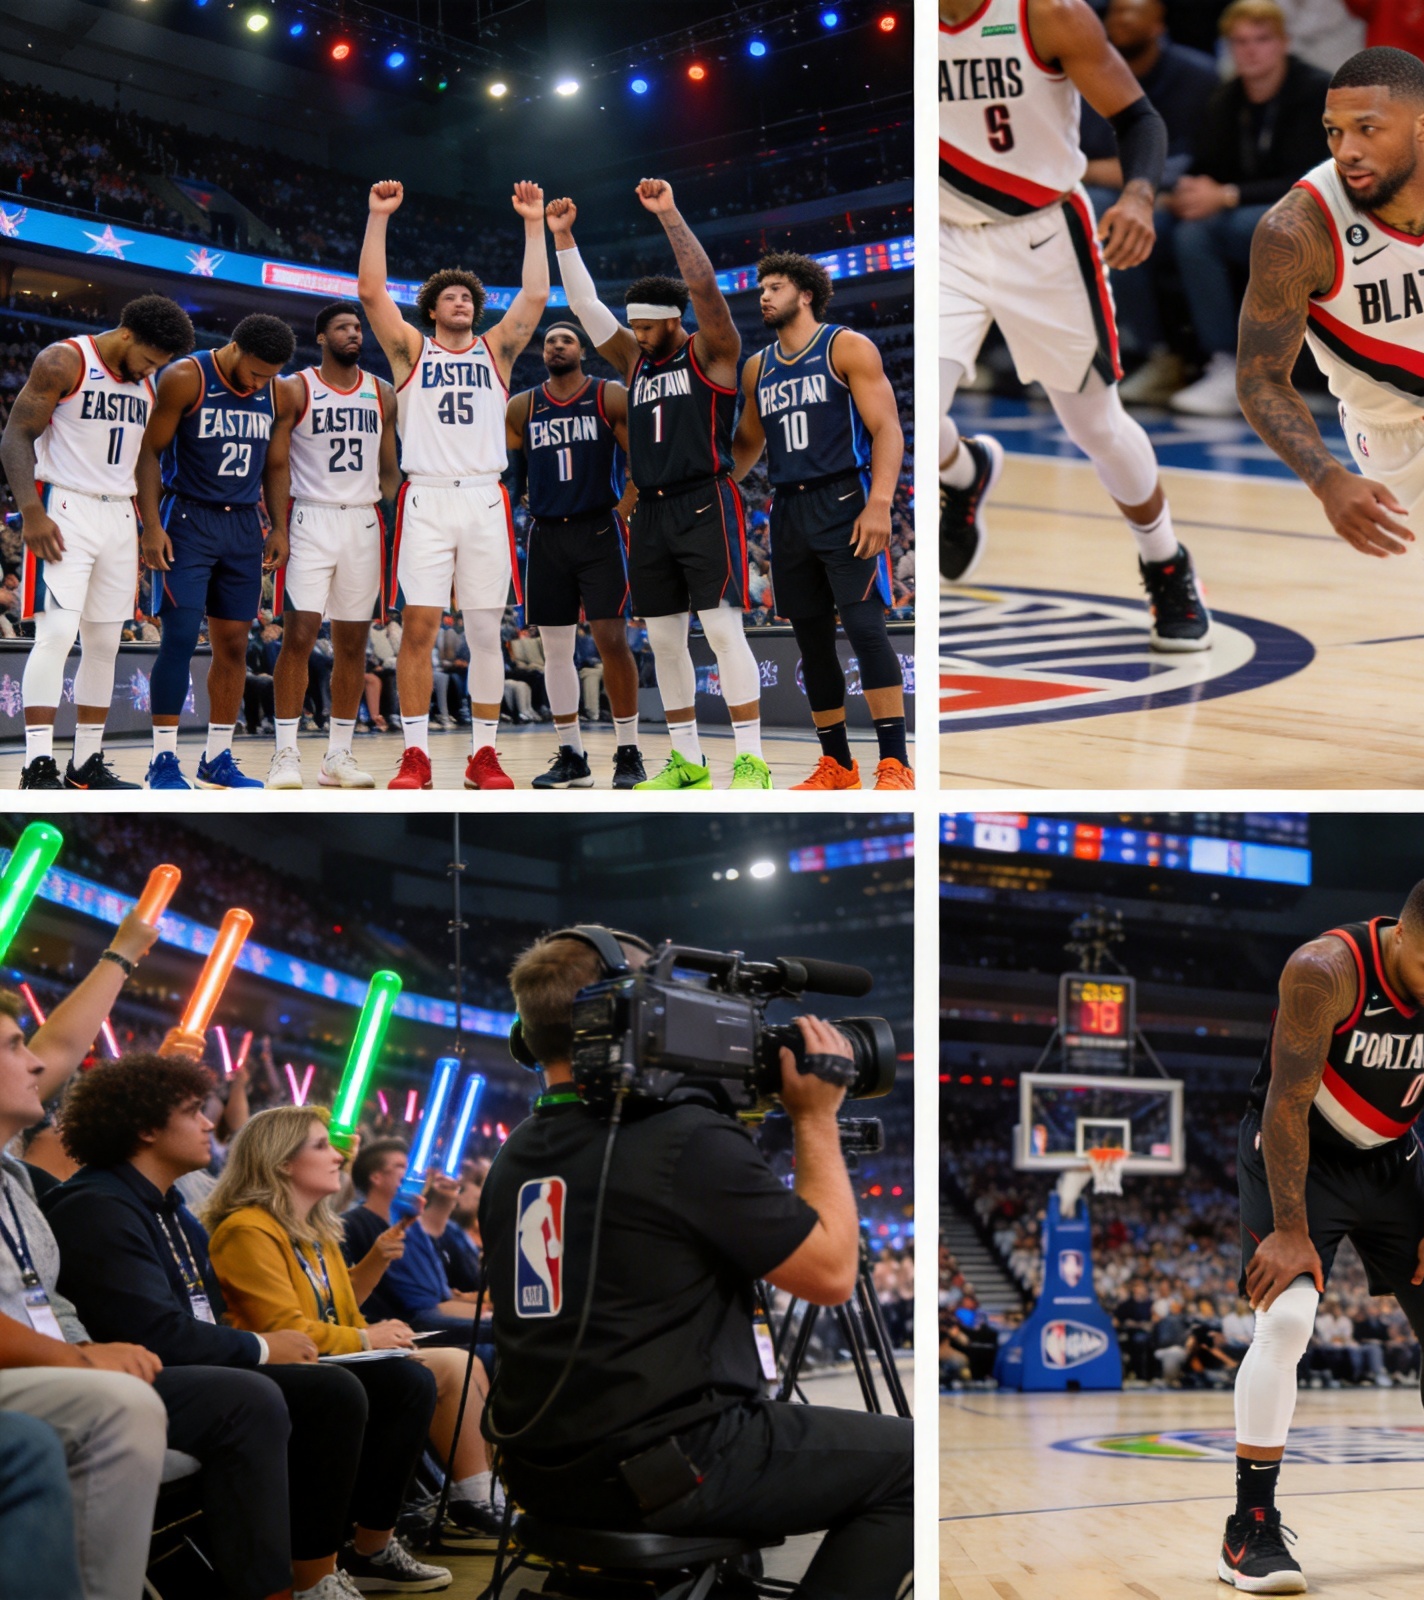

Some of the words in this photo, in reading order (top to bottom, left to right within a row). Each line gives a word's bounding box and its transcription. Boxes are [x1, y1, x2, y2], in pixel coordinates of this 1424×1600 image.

[651, 404, 662, 443] 1
[778, 410, 809, 453] 10
[217, 442, 252, 477] 23
[328, 437, 363, 473] 23
